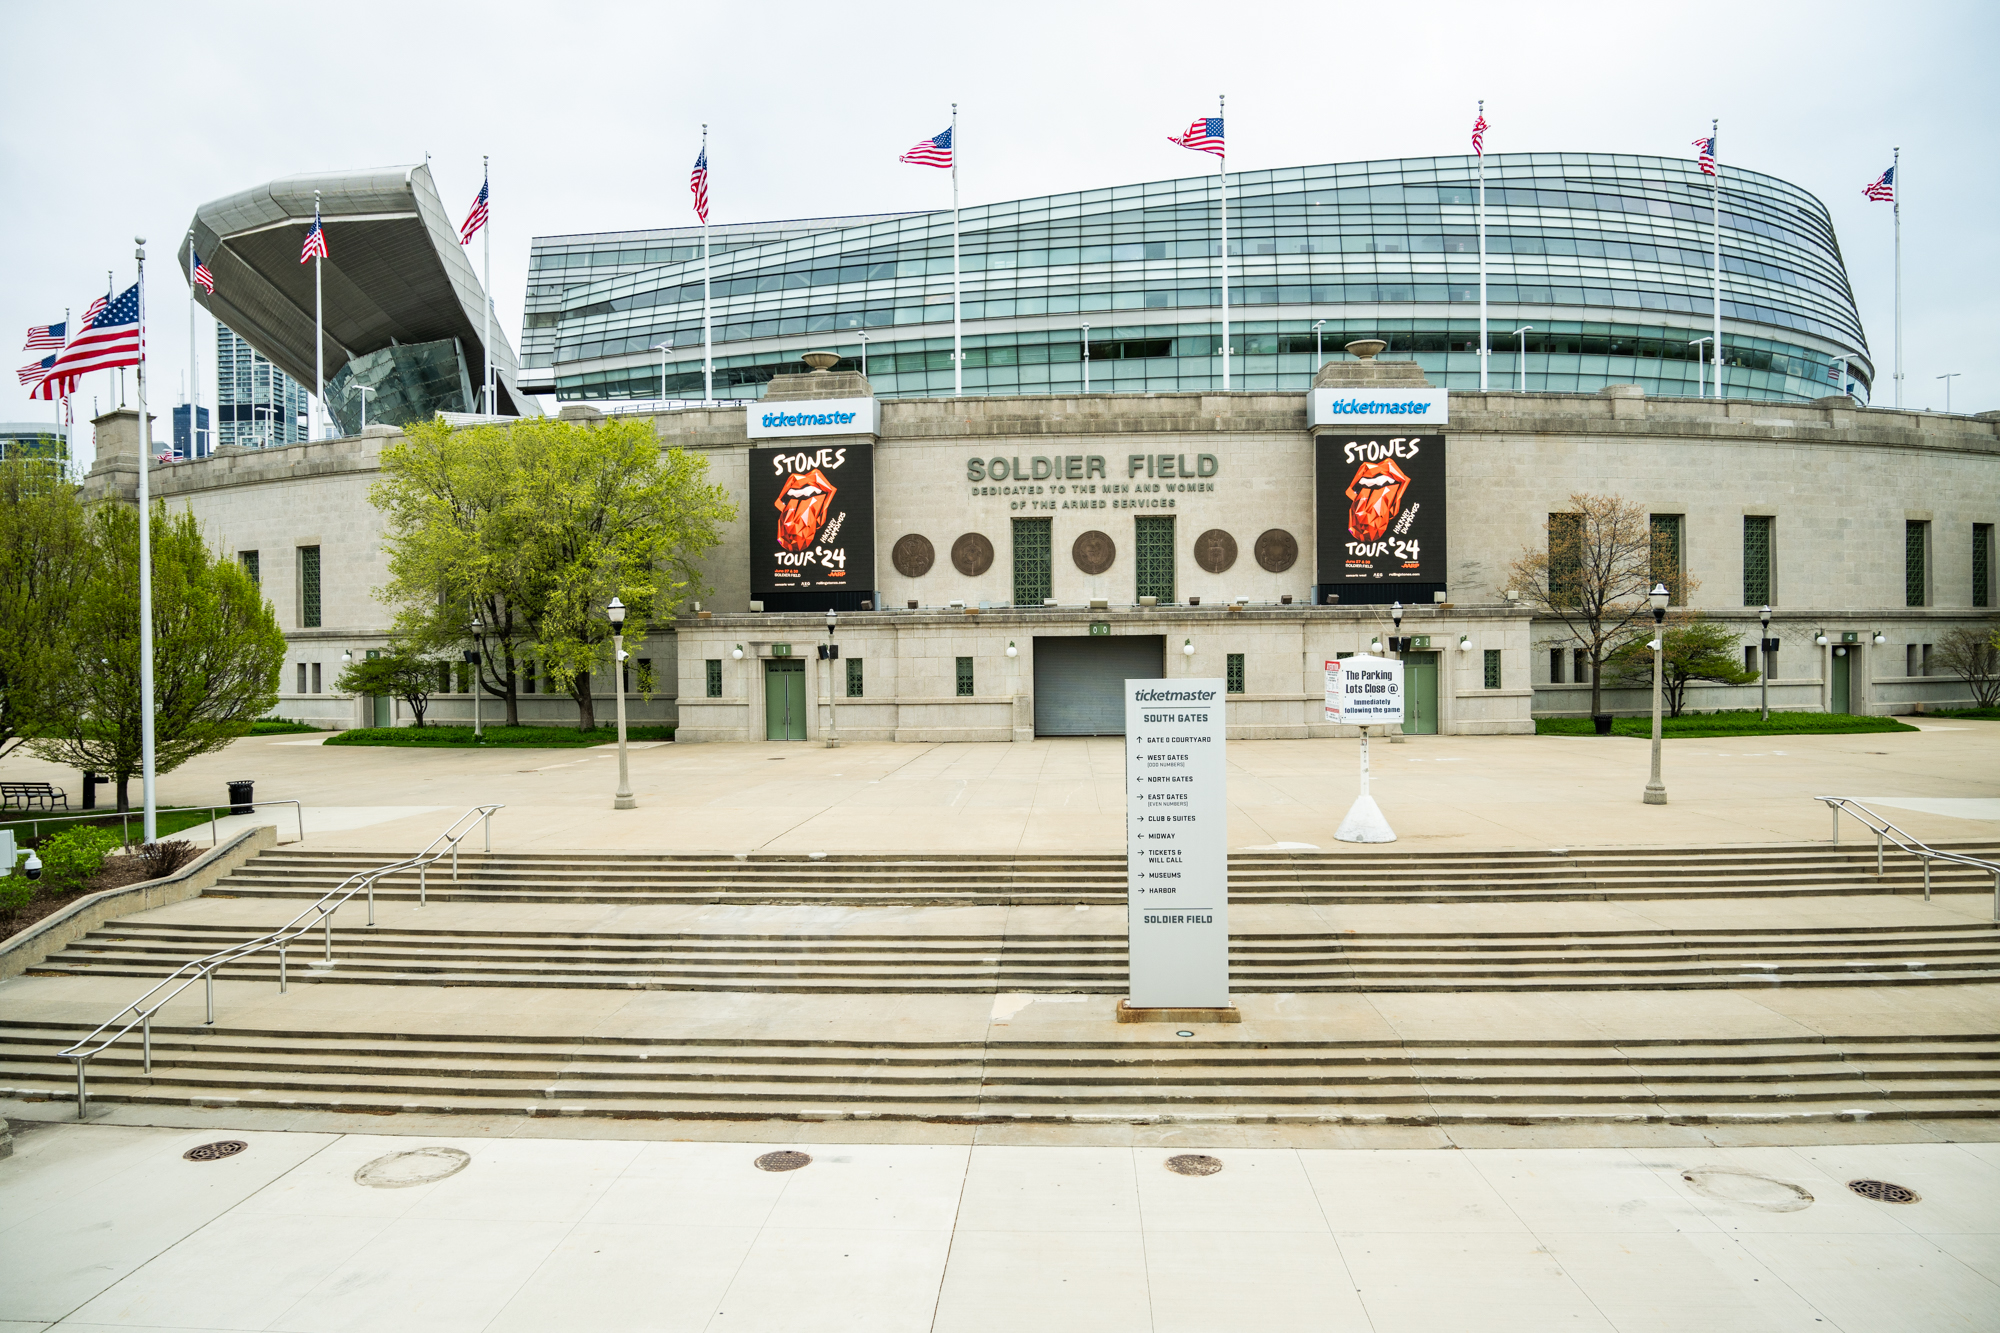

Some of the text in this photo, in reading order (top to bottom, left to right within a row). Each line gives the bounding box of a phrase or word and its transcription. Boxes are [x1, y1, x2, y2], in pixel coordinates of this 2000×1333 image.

[1332, 398, 1431, 415] ticketmaster
[762, 411, 856, 428] ticketmaster
[1344, 438, 1420, 464] STONES
[773, 448, 846, 476] STONES
[967, 454, 1218, 481] SOLDIER FIELD
[972, 482, 1215, 496] DEDICATED TO THE MEN AND WOMEN
[1010, 498, 1176, 510] OF THE ARMED SERVICES
[1345, 542, 1389, 558] TOUR
[774, 551, 816, 566] TOUR
[1346, 671, 1359, 680] The
[1362, 670, 1392, 681] Parking
[1135, 689, 1216, 701] ticketmaster
[1346, 683, 1398, 694] Lots Close @
[1178, 714, 1208, 722] GATES
